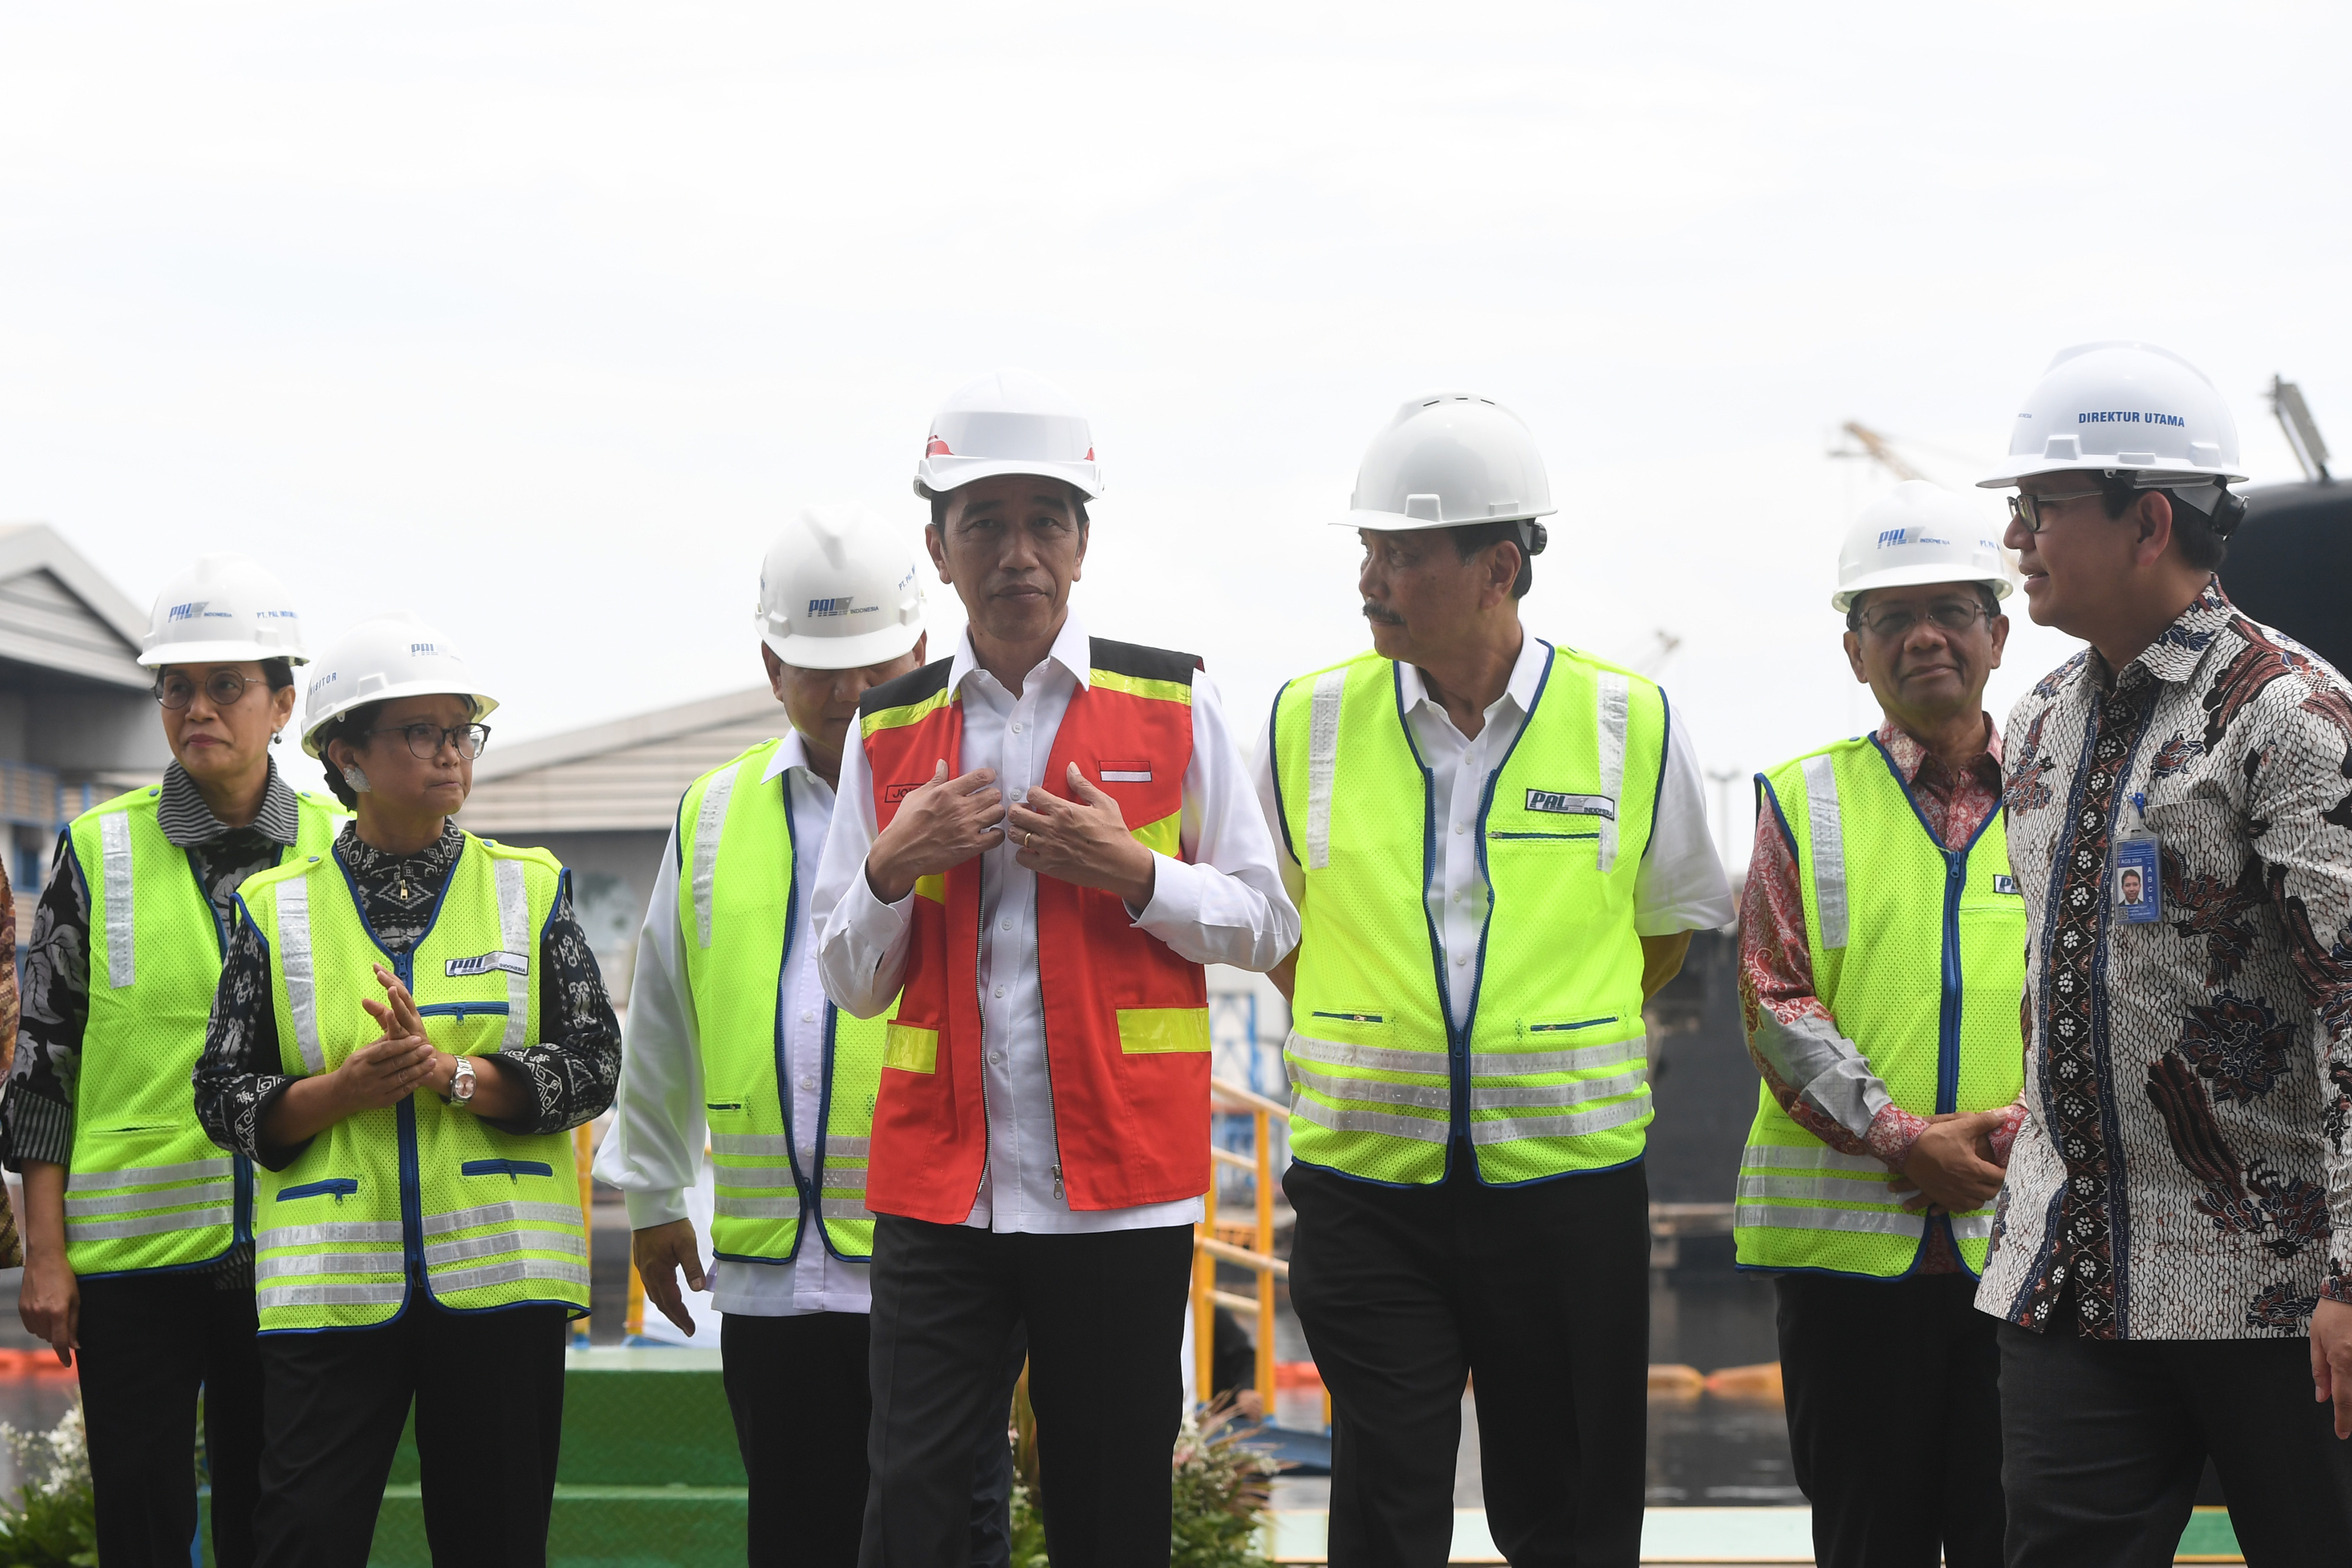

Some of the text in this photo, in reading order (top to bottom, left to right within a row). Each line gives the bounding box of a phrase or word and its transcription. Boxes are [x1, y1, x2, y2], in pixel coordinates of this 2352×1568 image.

[2079, 412, 2185, 427] DIREKTUR UTAMA
[1877, 528, 1907, 549] PAL
[168, 603, 192, 623] PAL
[808, 599, 878, 617] PAL INDONESIA
[411, 643, 438, 657] PAL
[309, 672, 336, 696] VISITOR
[1529, 792, 1568, 810] PAL
[449, 957, 486, 974] PAL
